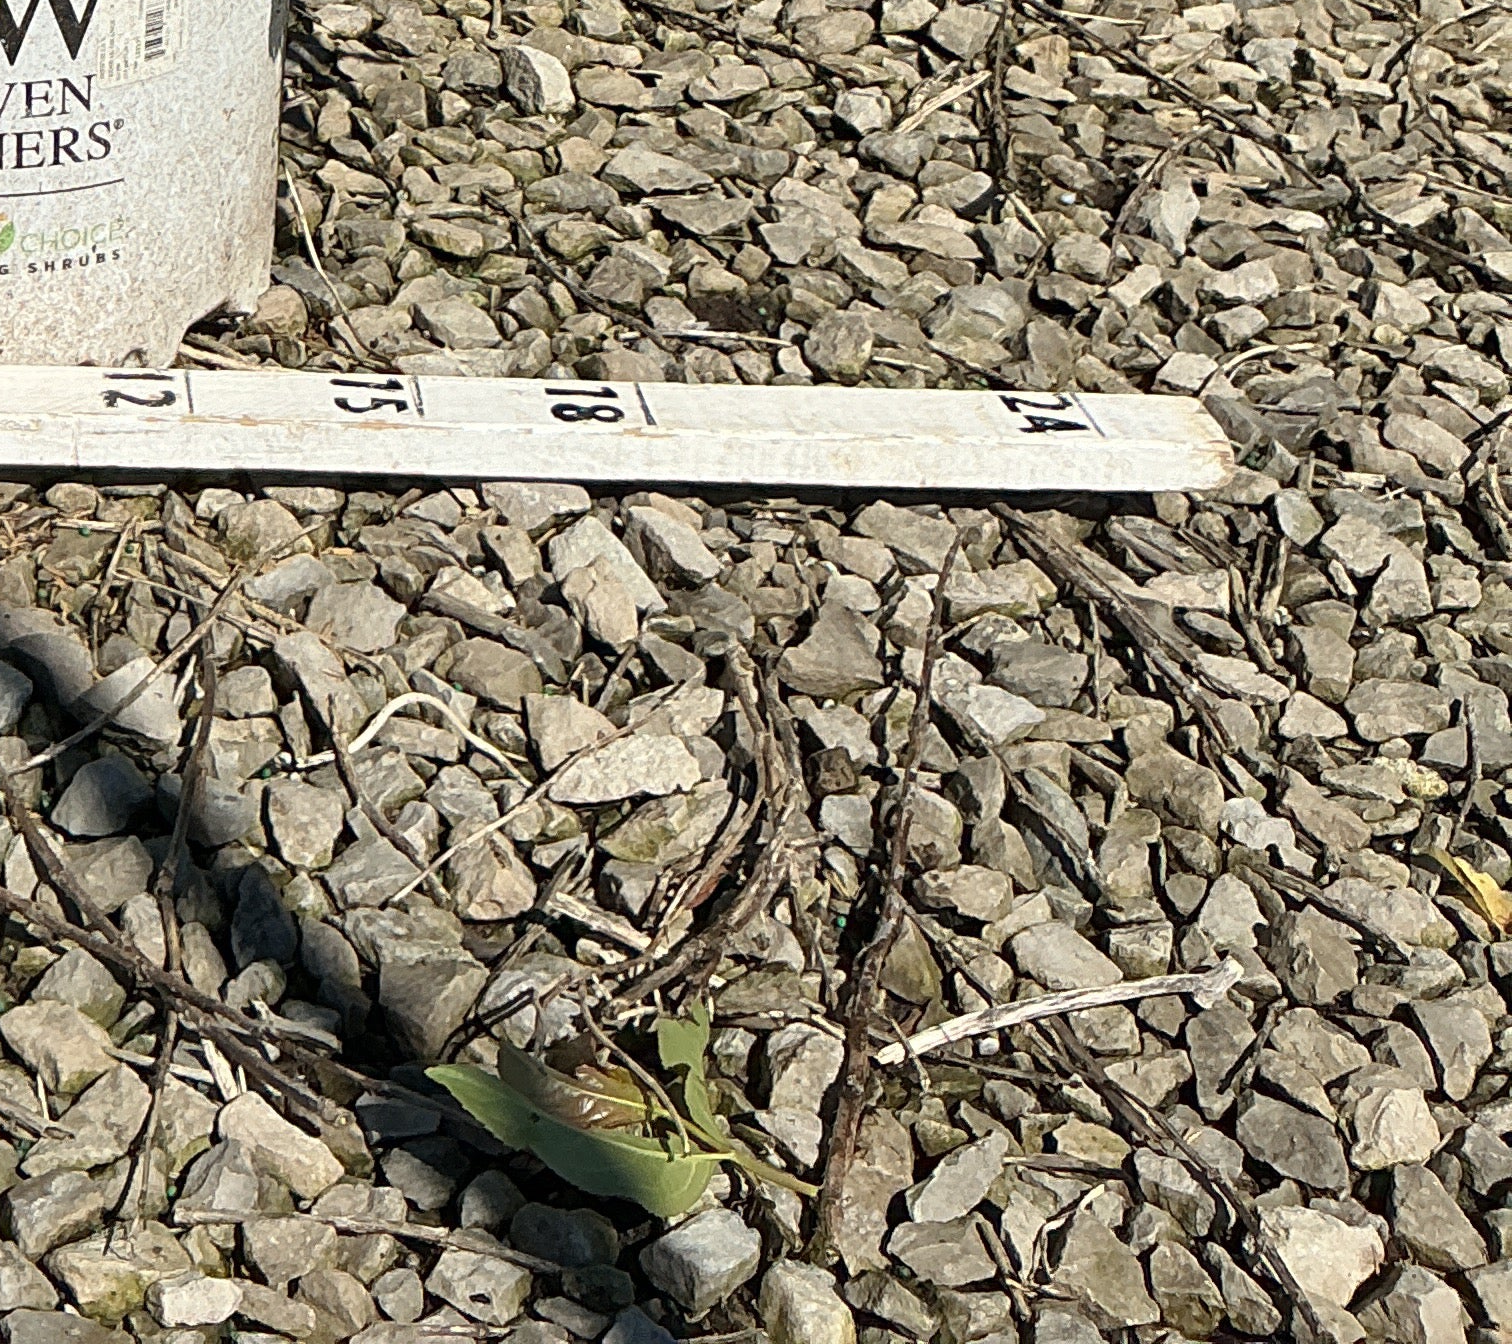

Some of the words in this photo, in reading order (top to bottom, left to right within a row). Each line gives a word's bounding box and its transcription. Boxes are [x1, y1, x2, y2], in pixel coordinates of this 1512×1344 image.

[26, 247, 122, 275] SHRUBS
[101, 372, 177, 408] 12
[329, 378, 409, 413] 15
[544, 387, 625, 423] 18
[997, 394, 1090, 434] 24
